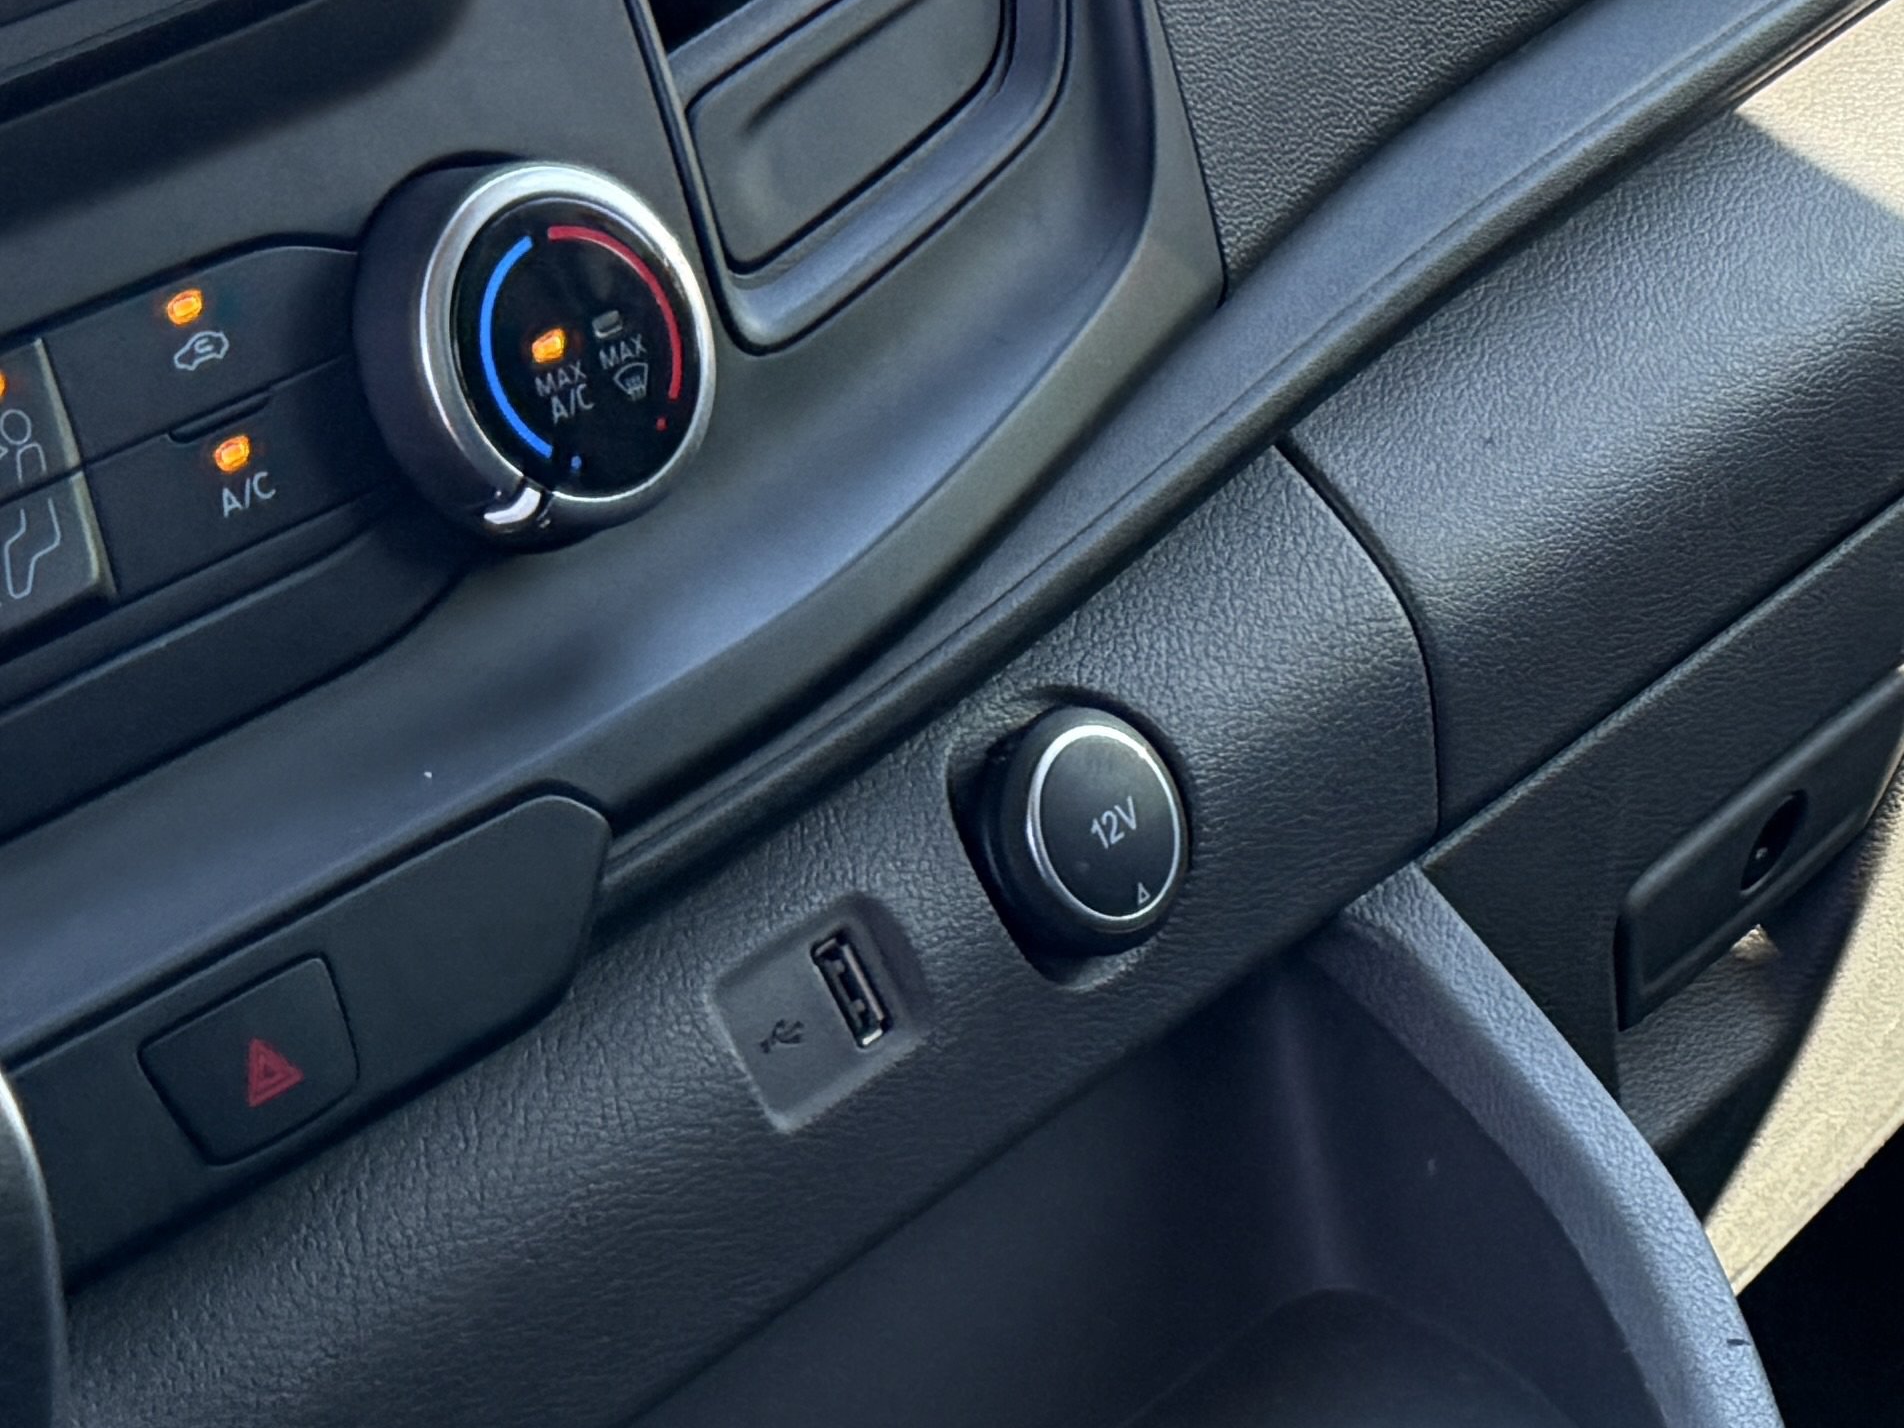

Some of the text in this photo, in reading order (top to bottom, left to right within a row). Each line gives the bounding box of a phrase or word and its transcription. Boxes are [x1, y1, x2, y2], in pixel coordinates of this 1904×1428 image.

[599, 334, 645, 371] MAX
[535, 360, 587, 397] MAX
[550, 383, 595, 423] A/C
[221, 470, 276, 517] A/C
[1090, 795, 1137, 850] 12V
